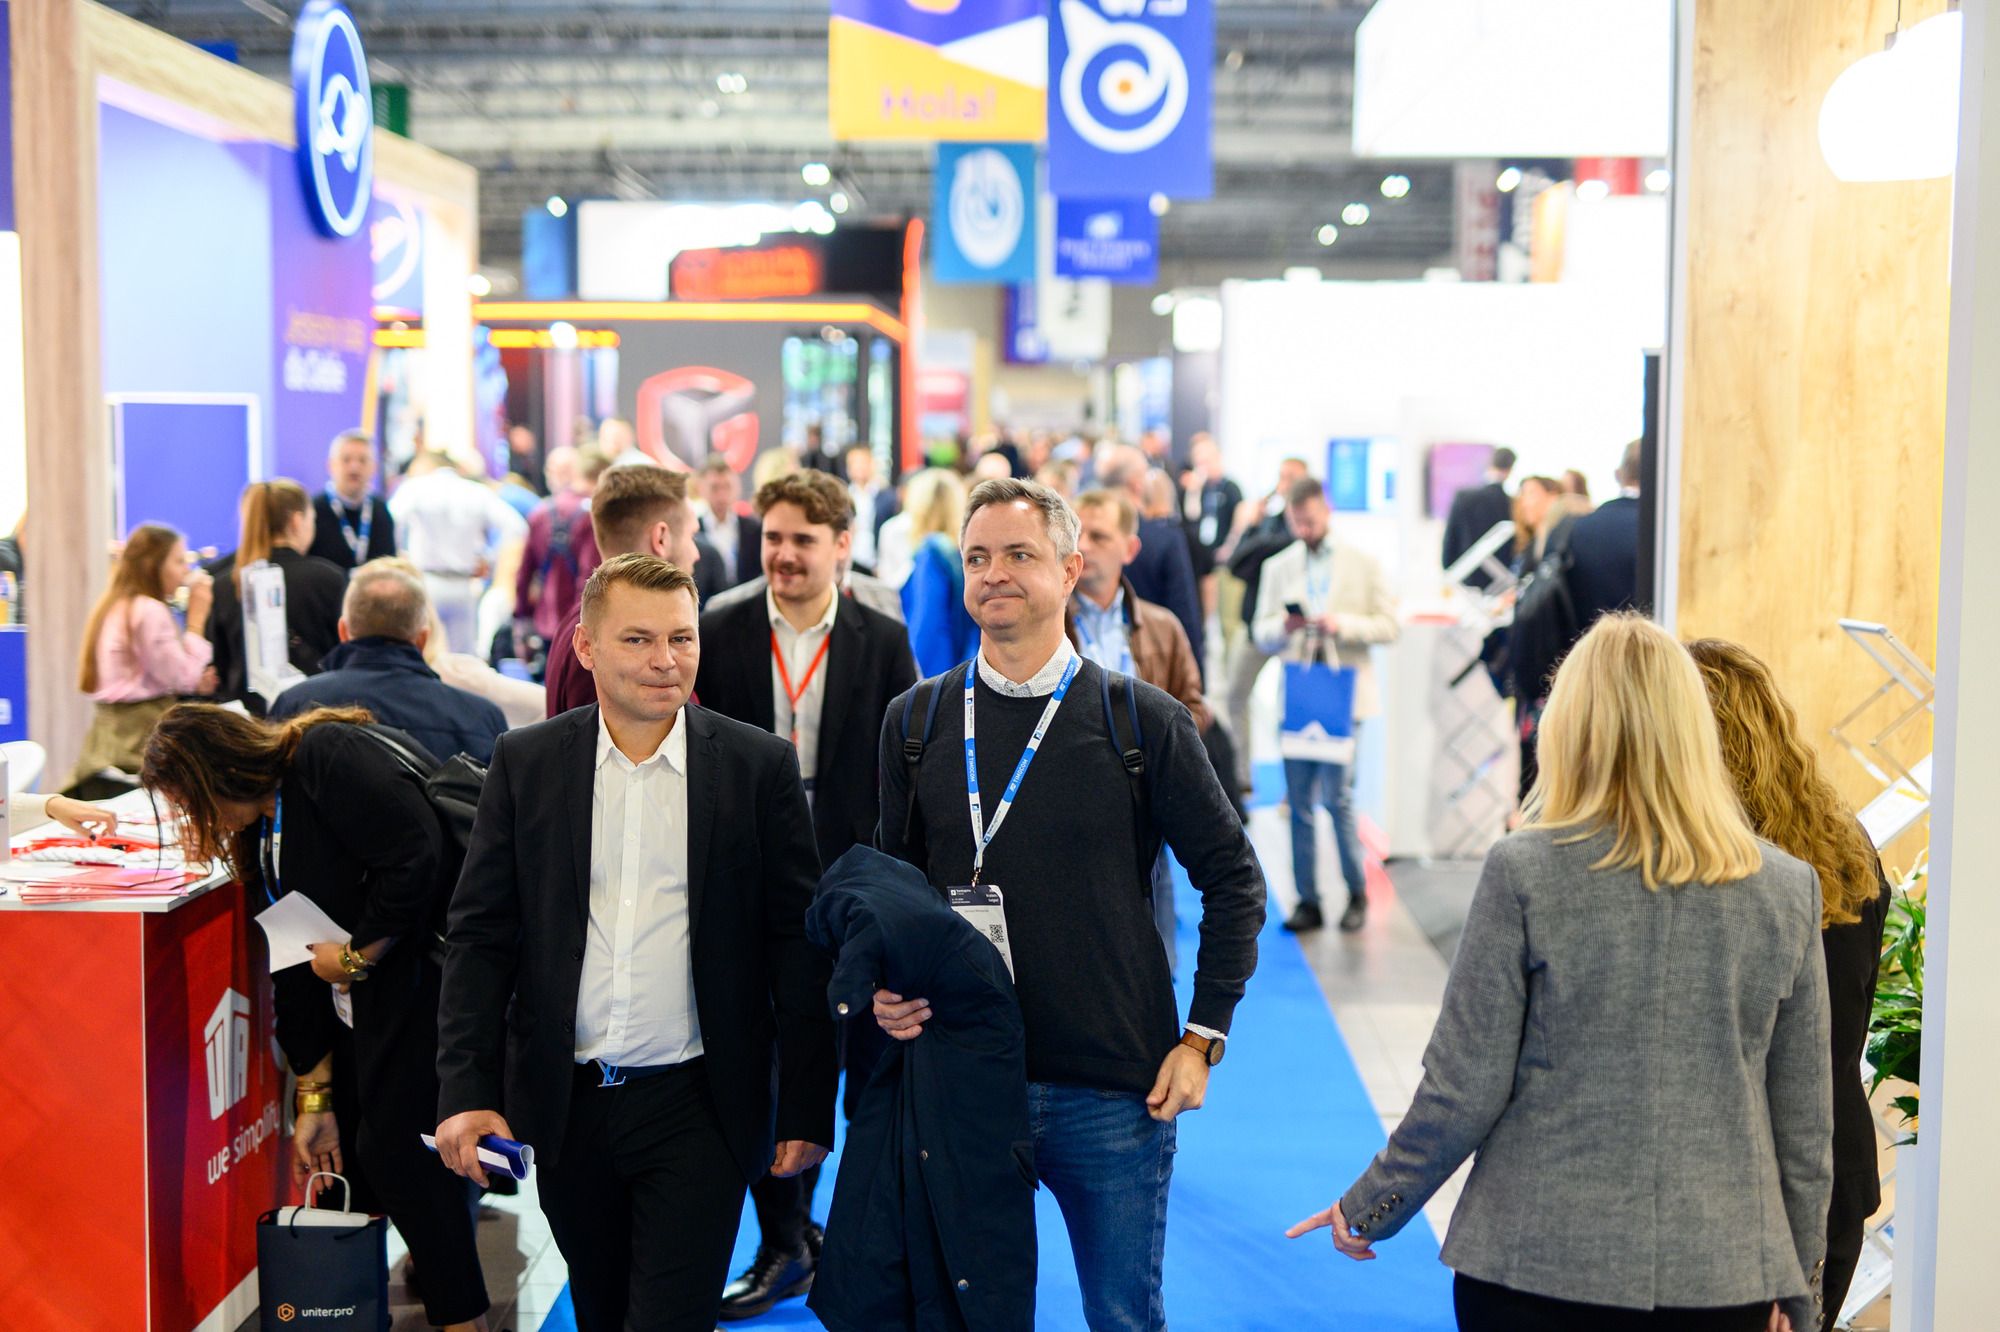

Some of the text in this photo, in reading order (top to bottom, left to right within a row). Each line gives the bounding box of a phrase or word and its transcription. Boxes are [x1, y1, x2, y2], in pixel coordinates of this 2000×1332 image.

[881, 84, 997, 122] Hola!
[968, 756, 976, 782] TIMOCOM
[1013, 758, 1029, 783] TIMOCOM
[204, 987, 250, 1121] UTA
[207, 1145, 231, 1185] we
